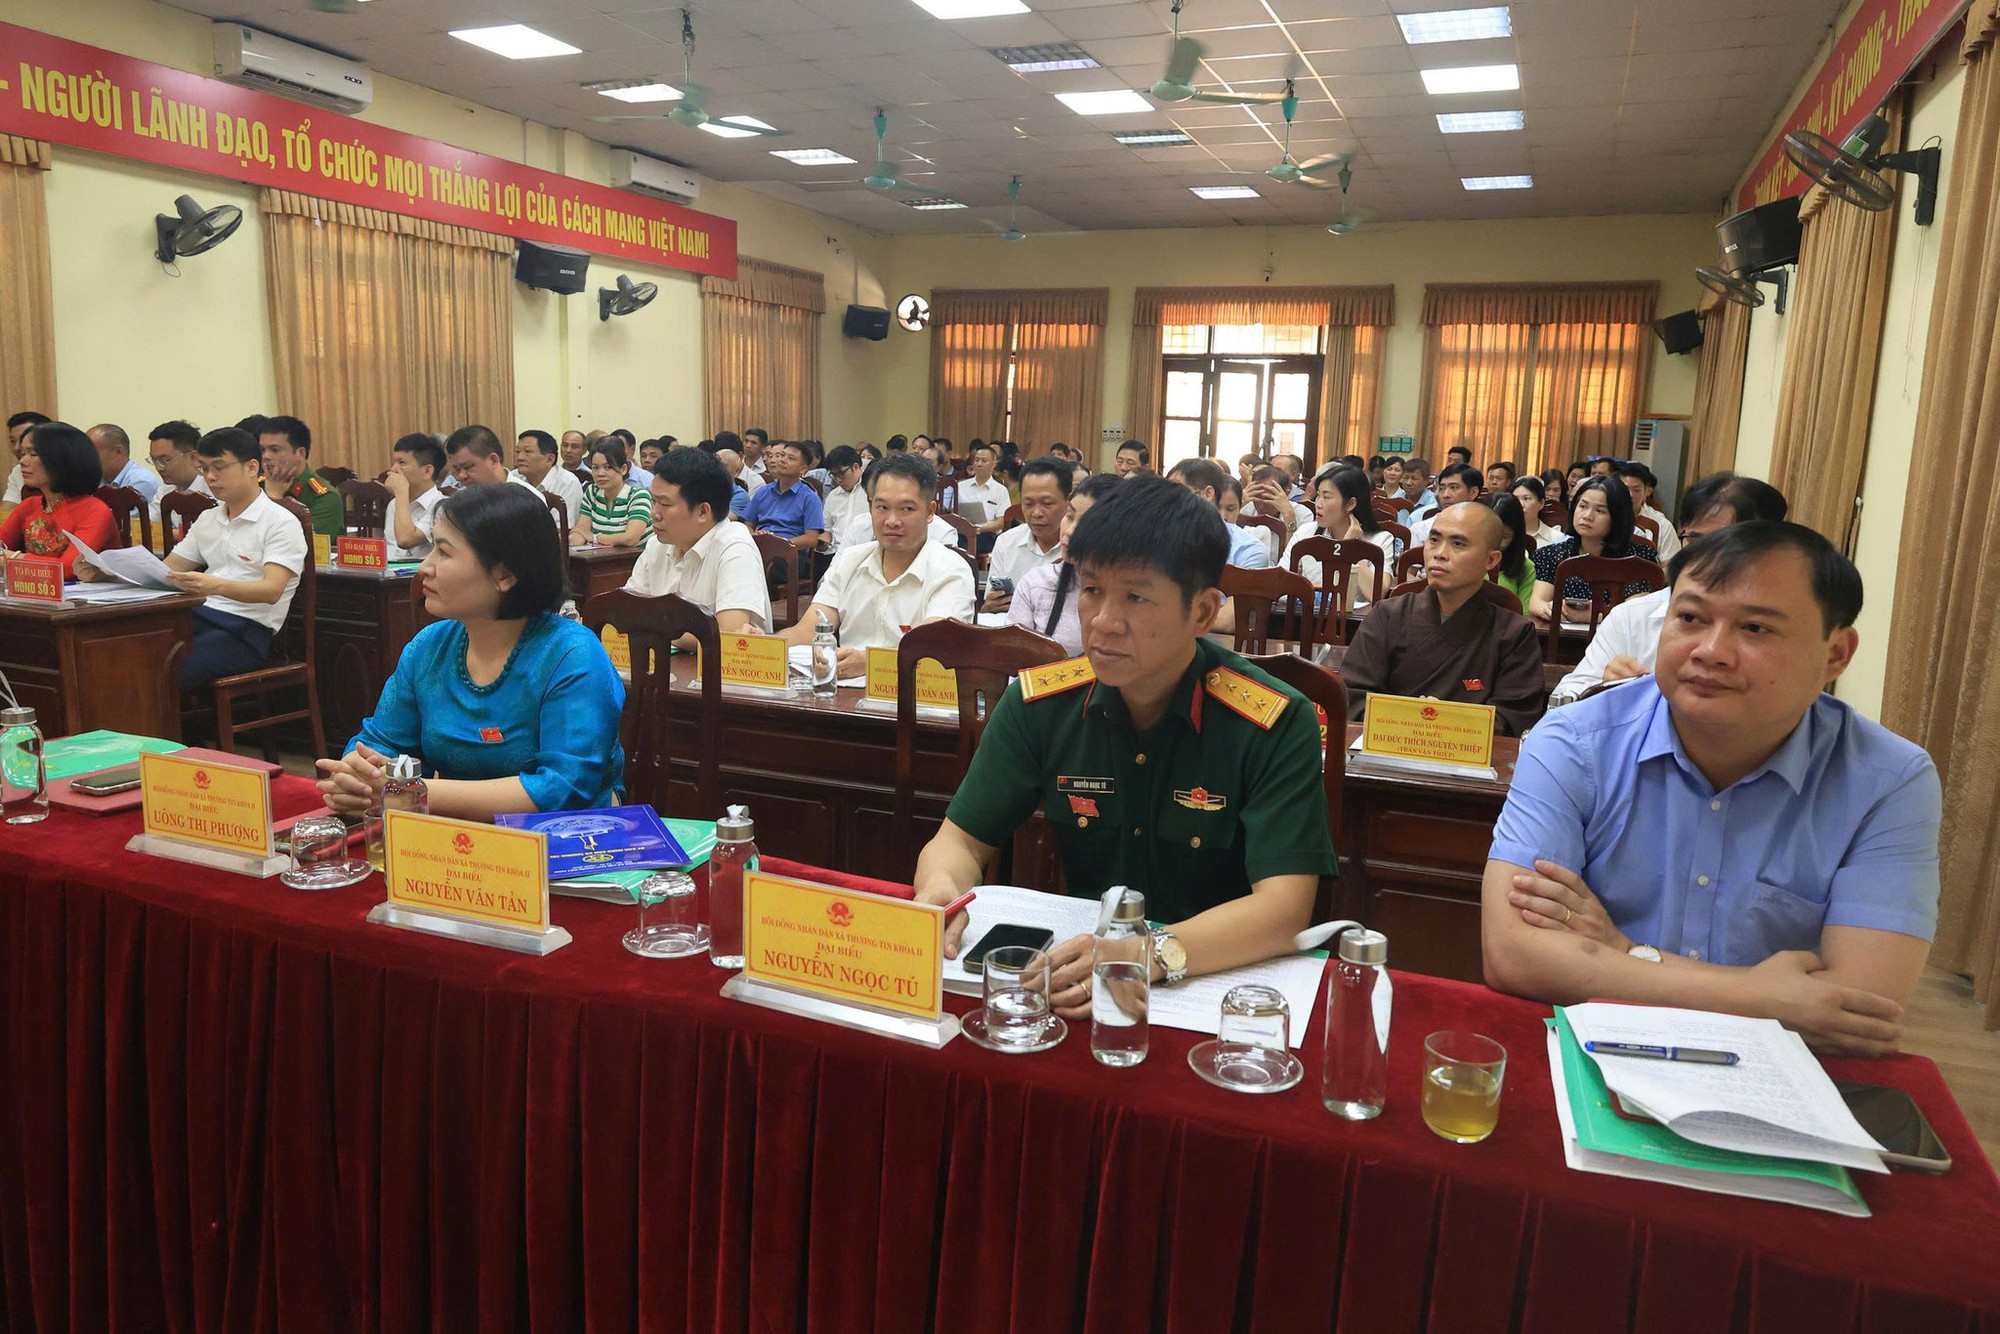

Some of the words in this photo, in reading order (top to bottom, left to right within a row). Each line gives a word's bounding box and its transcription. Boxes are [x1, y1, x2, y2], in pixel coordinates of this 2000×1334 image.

[20, 62, 122, 131] NGƯỜI
[132, 87, 208, 149] LÃNH
[215, 112, 275, 170] ĐẠO,
[281, 119, 312, 172] TỔ
[319, 138, 378, 188] CHỨC
[385, 154, 424, 204] MỌI
[429, 159, 489, 213] THẮNG
[495, 181, 521, 225] LỢI
[526, 182, 558, 227] CỦA
[562, 194, 601, 236] CÁCH
[605, 209, 645, 249] MẠNG
[648, 218, 675, 257] VIỆT
[678, 226, 709, 259] NAM!
[1333, 543, 1341, 556] 2
[37, 579, 49, 596] SỐ
[50, 584, 56, 596] 3
[764, 672, 781, 681] ANH
[187, 817, 207, 835] THỊ
[211, 821, 259, 842] PHƯỢNG
[406, 877, 462, 901] NGUYỄN
[466, 888, 494, 907] VĂN
[498, 892, 527, 913] TẢN
[817, 942, 834, 953] ĐẠI
[764, 949, 834, 979] NGUYỄN
[840, 966, 889, 992] NGỌC
[894, 976, 918, 997] TÚ
